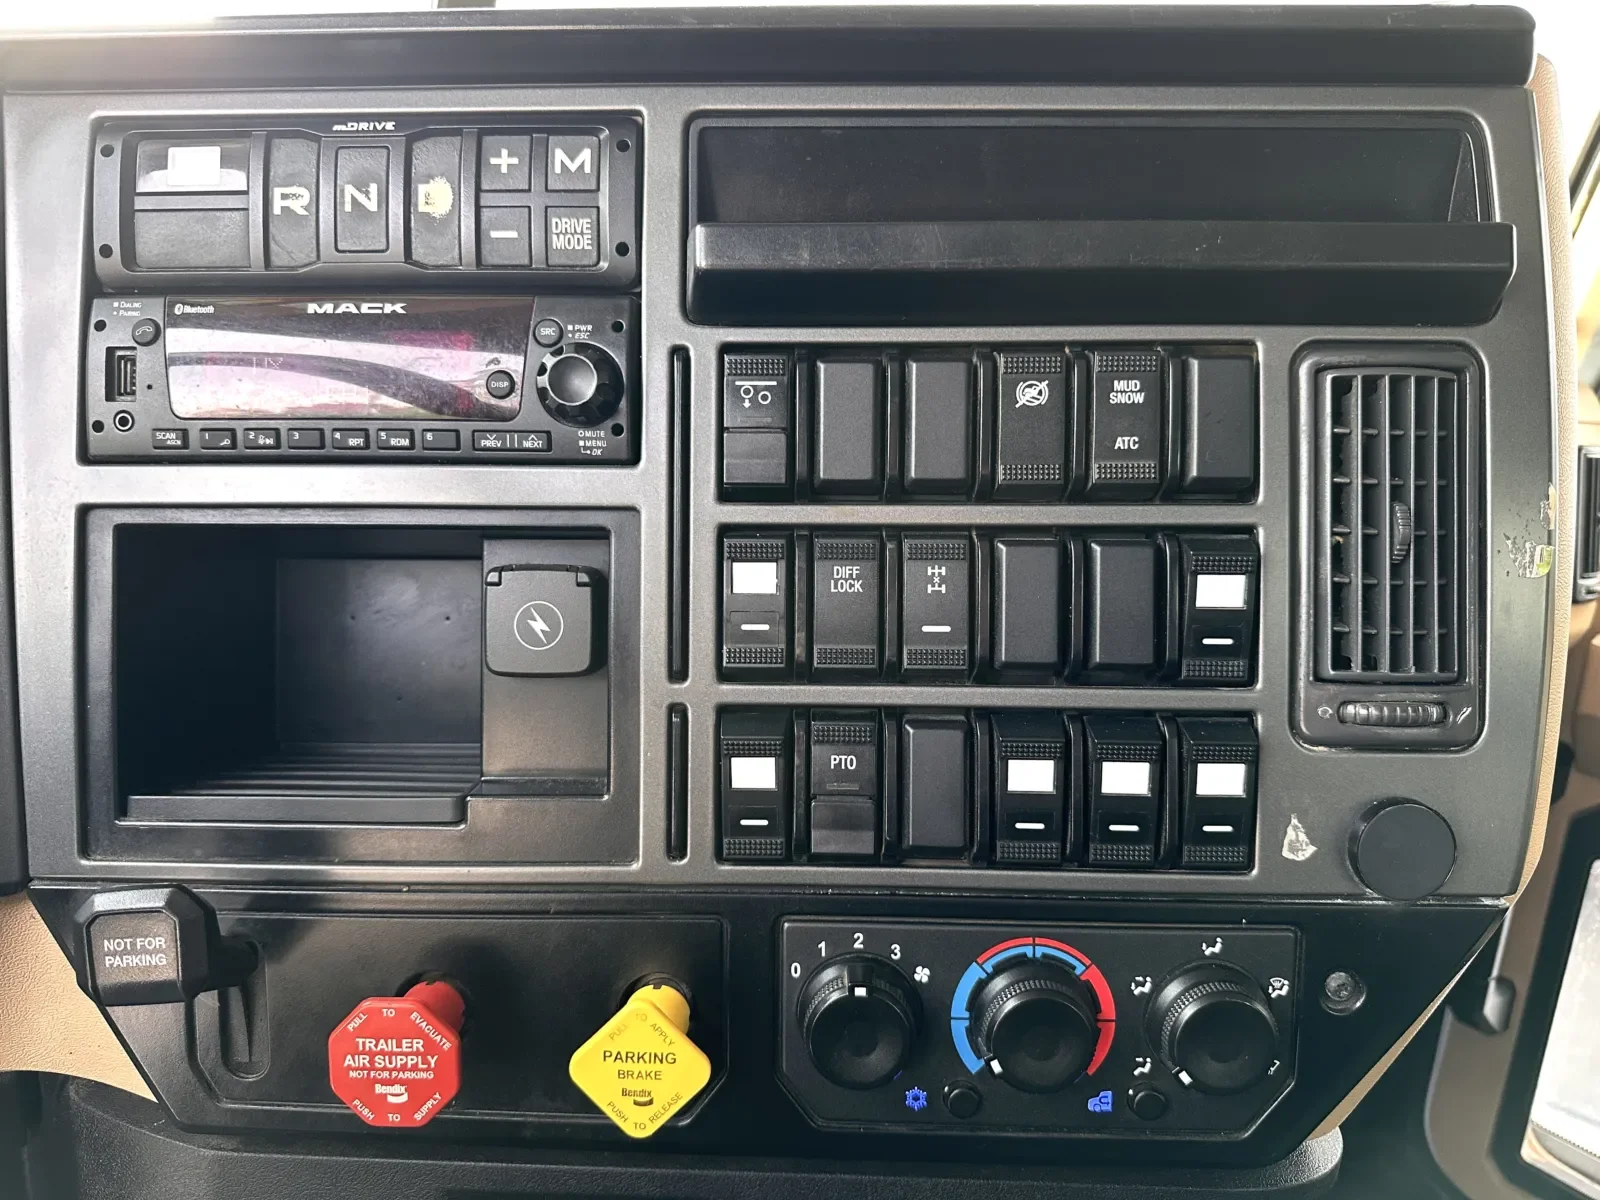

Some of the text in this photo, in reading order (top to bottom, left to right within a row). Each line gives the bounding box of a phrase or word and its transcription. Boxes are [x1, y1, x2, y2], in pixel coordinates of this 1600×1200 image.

[332, 121, 396, 131] mDRIVE
[554, 148, 592, 174] M
[272, 185, 310, 216] R
[344, 182, 378, 213] N
[551, 217, 592, 234] DRIVE
[552, 234, 593, 250] MODE
[182, 304, 215, 315] Bluetooth
[307, 302, 407, 315] MACK
[539, 327, 556, 337] SRC
[574, 324, 593, 333] PWR
[574, 332, 591, 340] ESC
[490, 380, 510, 390] DISP
[1113, 379, 1141, 392] MUD
[1109, 391, 1145, 405] SNOW
[155, 431, 177, 440] SCAN
[204, 432, 210, 441] 1
[247, 431, 256, 440] 2
[292, 432, 300, 440] 3
[334, 431, 341, 440] 4
[380, 431, 388, 440] 5
[426, 432, 434, 441] 6
[585, 430, 606, 438] MUTE
[348, 437, 365, 447] RPT
[390, 437, 410, 447] RDM
[480, 440, 503, 448] PREV
[522, 440, 544, 449] NEXT
[585, 439, 608, 448] MENU
[1114, 436, 1139, 450] ATC
[590, 448, 604, 456] OK
[833, 565, 861, 579] DIFF
[830, 579, 864, 593] LOCK
[830, 754, 857, 770] PTO
[103, 936, 166, 952] NOT FOR
[853, 932, 864, 949] 2
[817, 940, 827, 957] 1
[890, 943, 901, 960] 3
[104, 953, 168, 968] PARKING
[346, 1008, 453, 1052] PULL TO EVACUATE
[649, 1022, 676, 1048] APPLY
[355, 1037, 425, 1053] TRAILER
[343, 1054, 439, 1069] AIR SUPPLY
[602, 1049, 677, 1065] PARKING
[349, 1069, 434, 1080] NOT FOR PARKING
[617, 1068, 663, 1081] BRAKE
[374, 1083, 407, 1095] Bendix
[621, 1087, 653, 1099] Bendix
[351, 1091, 442, 1123] PUSH TO SUPPLY
[606, 1091, 684, 1131] PUSH TO RELEASE
